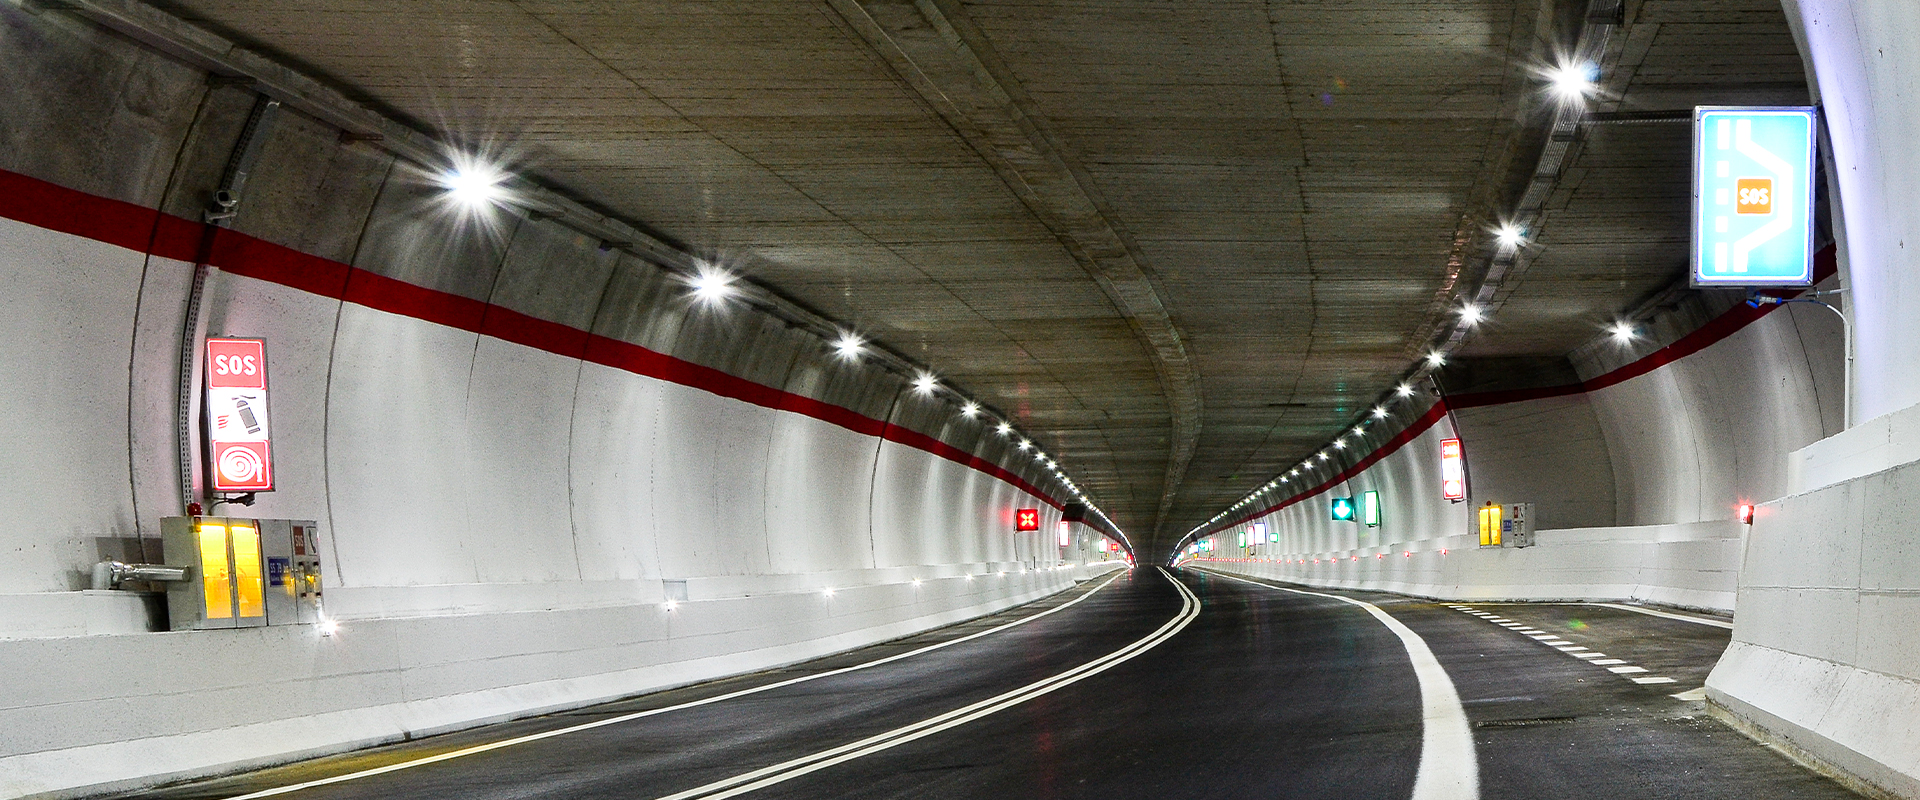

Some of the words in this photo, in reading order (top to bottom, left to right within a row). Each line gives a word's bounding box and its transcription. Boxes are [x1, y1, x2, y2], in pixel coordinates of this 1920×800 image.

[1740, 188, 1768, 204] SOS
[215, 354, 256, 376] SOS
[294, 535, 304, 546] SOS
